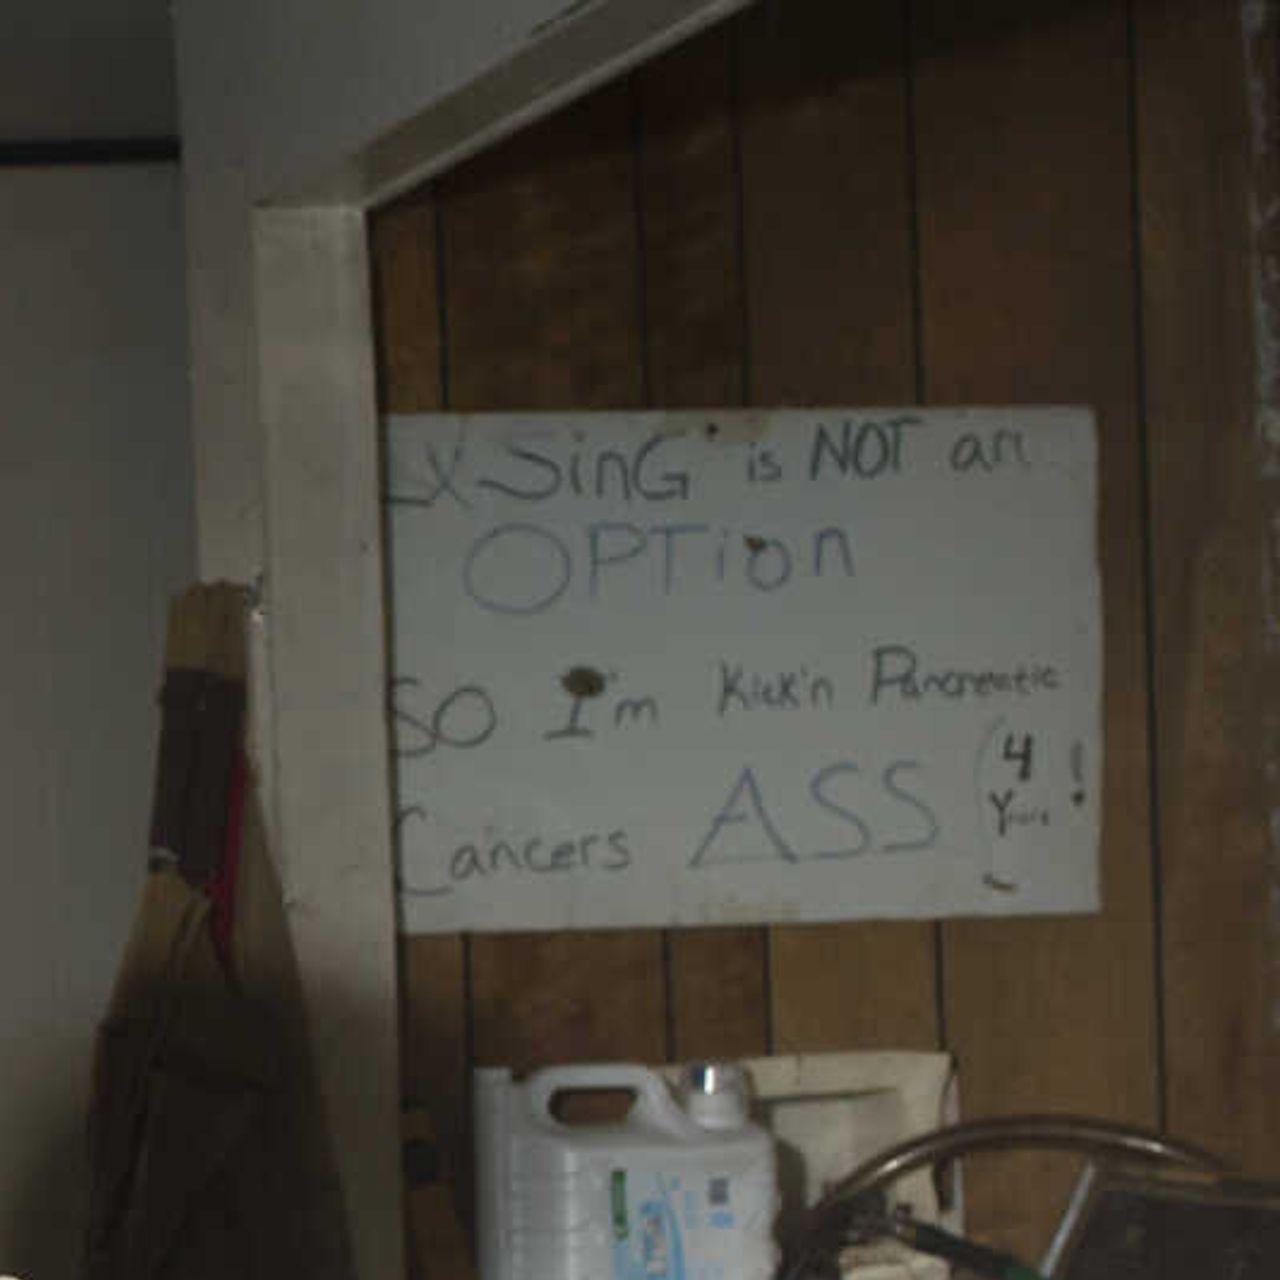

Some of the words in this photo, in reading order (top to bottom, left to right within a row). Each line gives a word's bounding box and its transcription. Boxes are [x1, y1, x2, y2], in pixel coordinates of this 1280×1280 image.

[809, 416, 922, 481] NOT
[950, 429, 1028, 473] an
[690, 760, 939, 865] ASS
